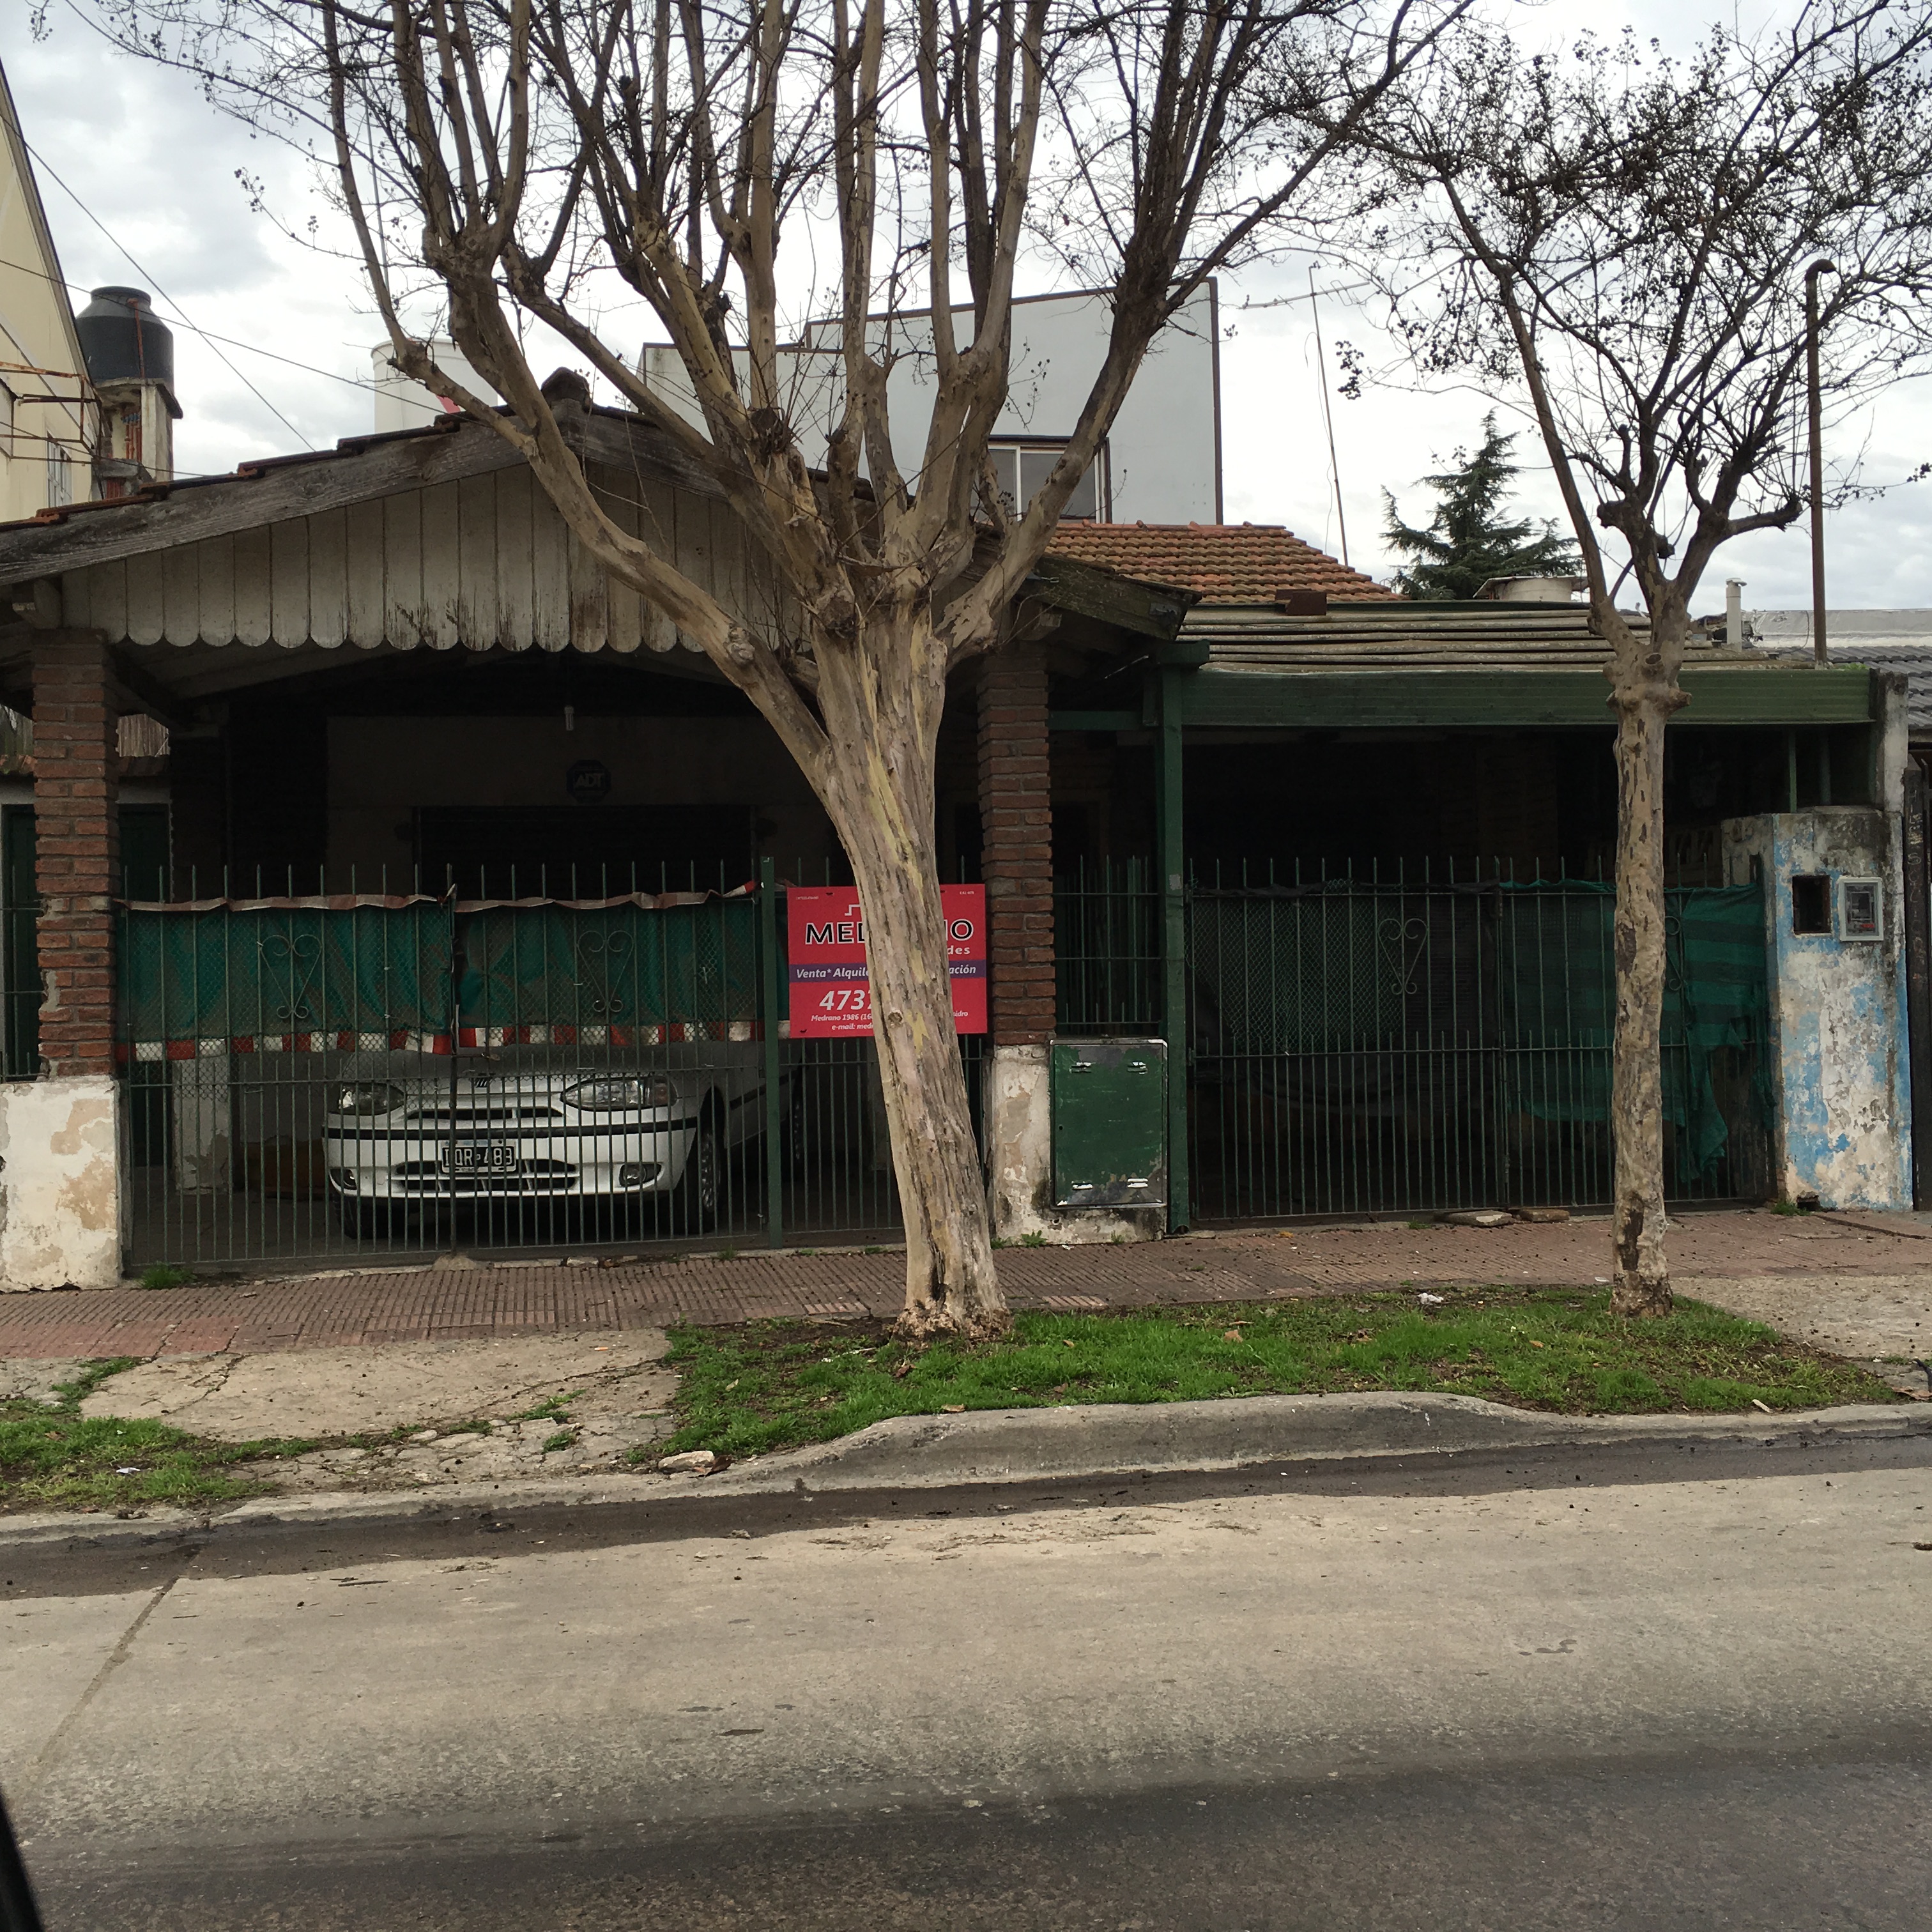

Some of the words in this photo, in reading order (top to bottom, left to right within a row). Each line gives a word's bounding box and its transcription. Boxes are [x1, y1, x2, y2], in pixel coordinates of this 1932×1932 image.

[574, 772, 605, 788] ADT
[947, 945, 970, 954] des
[949, 964, 976, 974] ación
